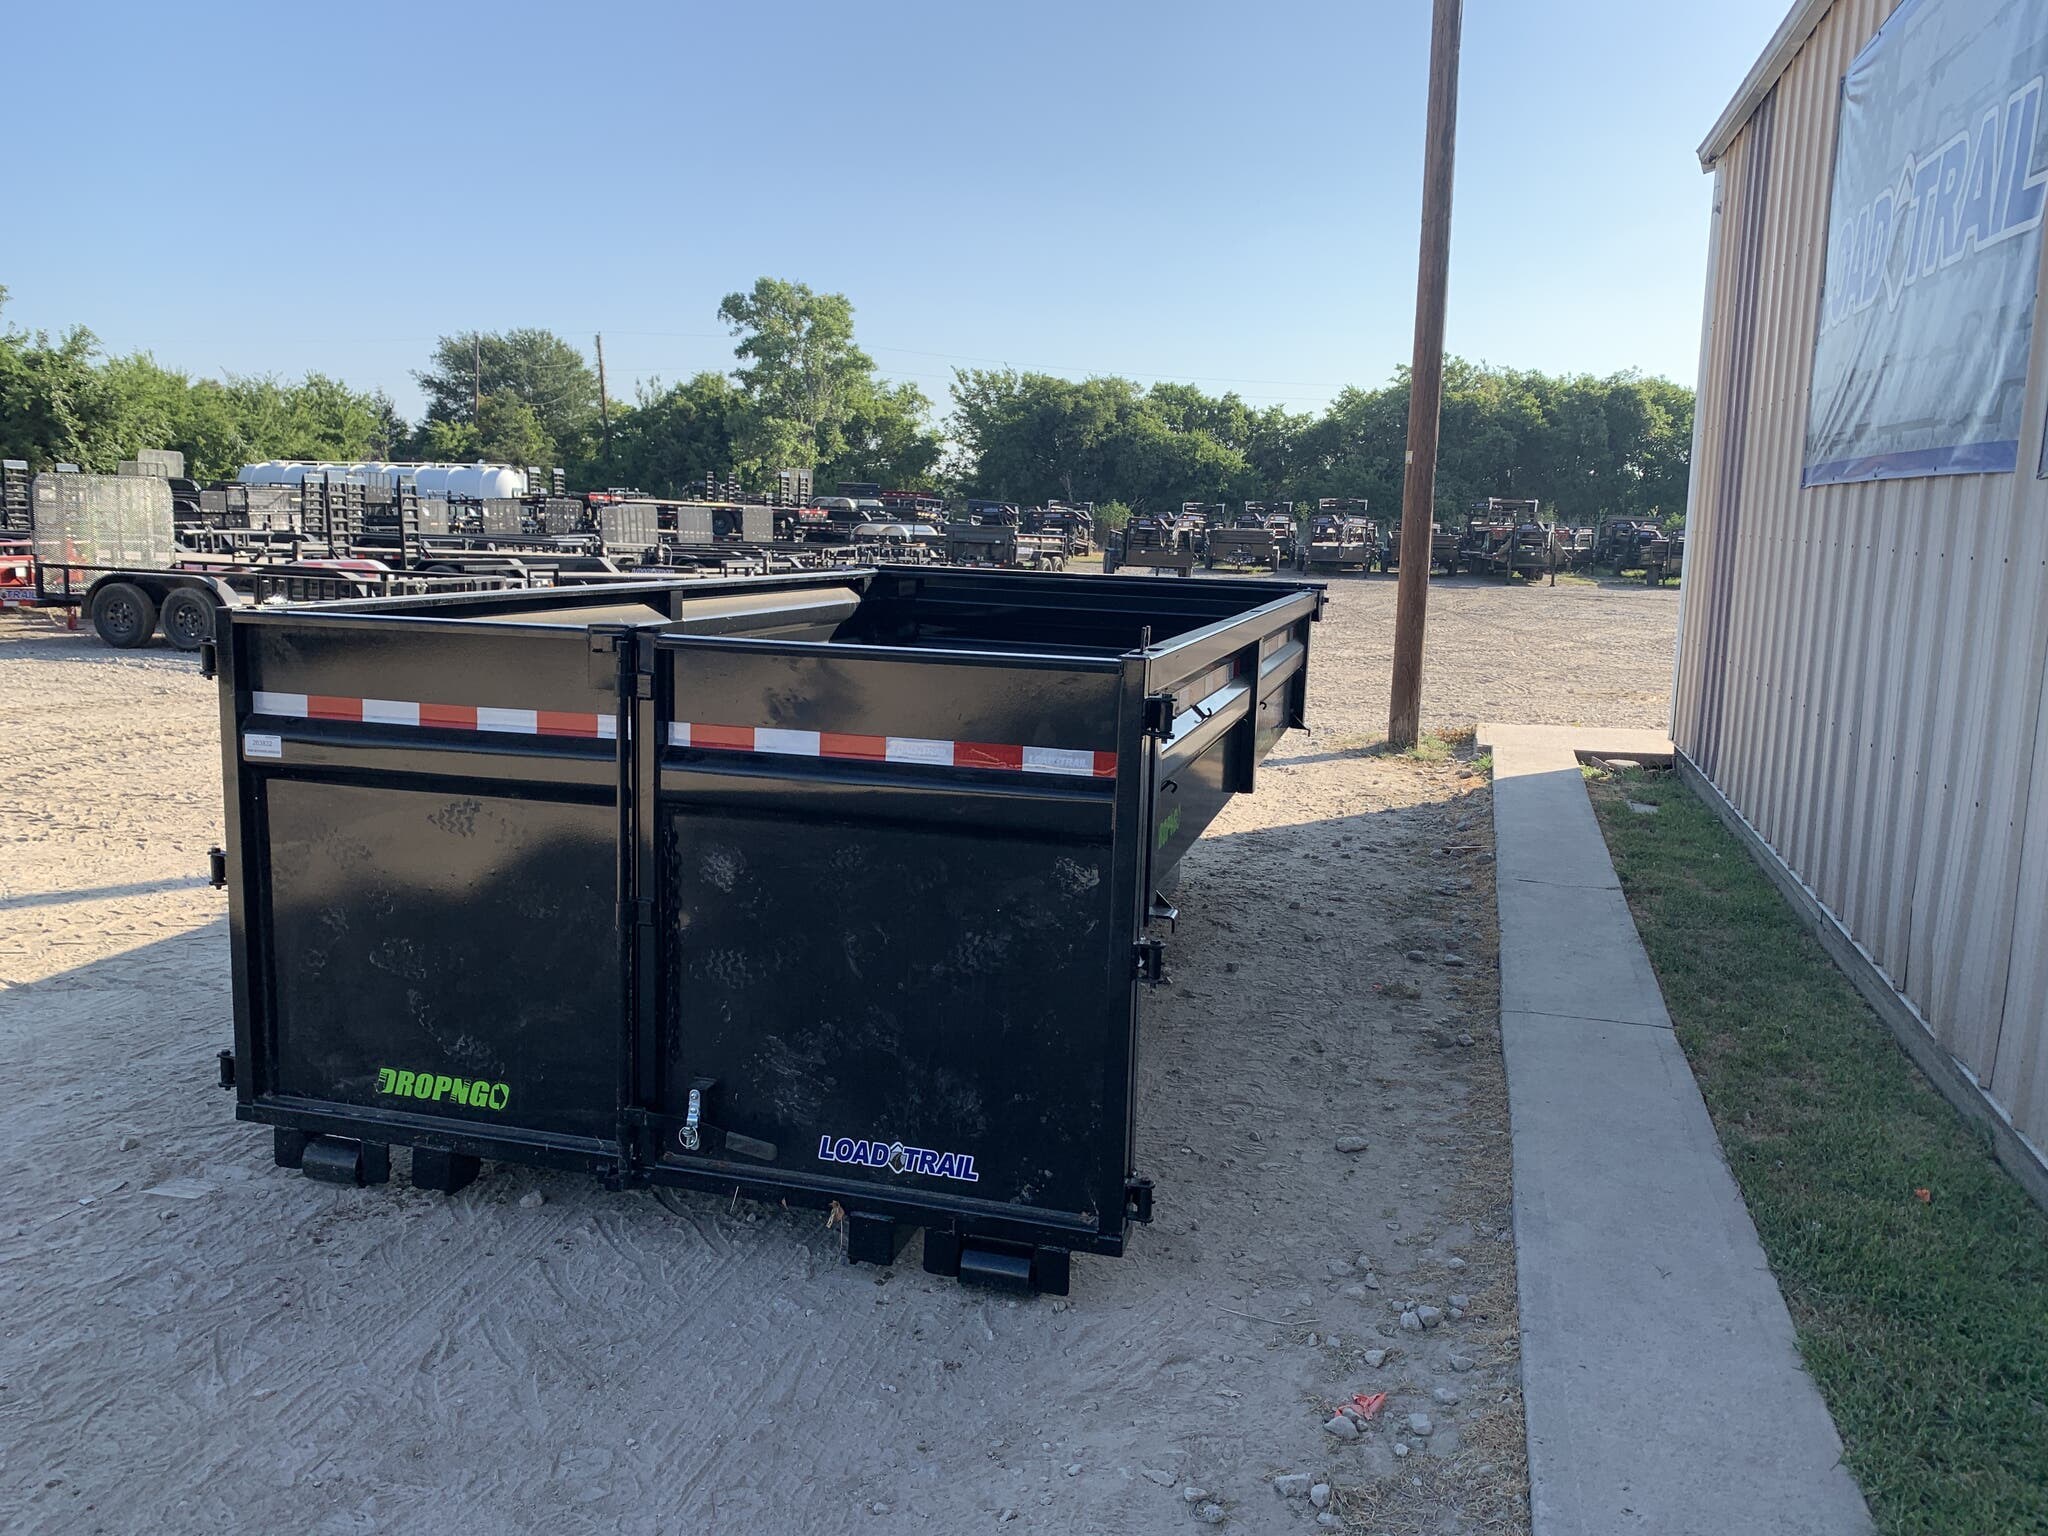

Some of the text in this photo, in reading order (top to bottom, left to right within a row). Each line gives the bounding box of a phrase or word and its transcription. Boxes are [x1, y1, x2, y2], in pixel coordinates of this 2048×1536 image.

[1904, 75, 2048, 287] TRAIL
[818, 1135, 979, 1182] LOAD TRAIL
